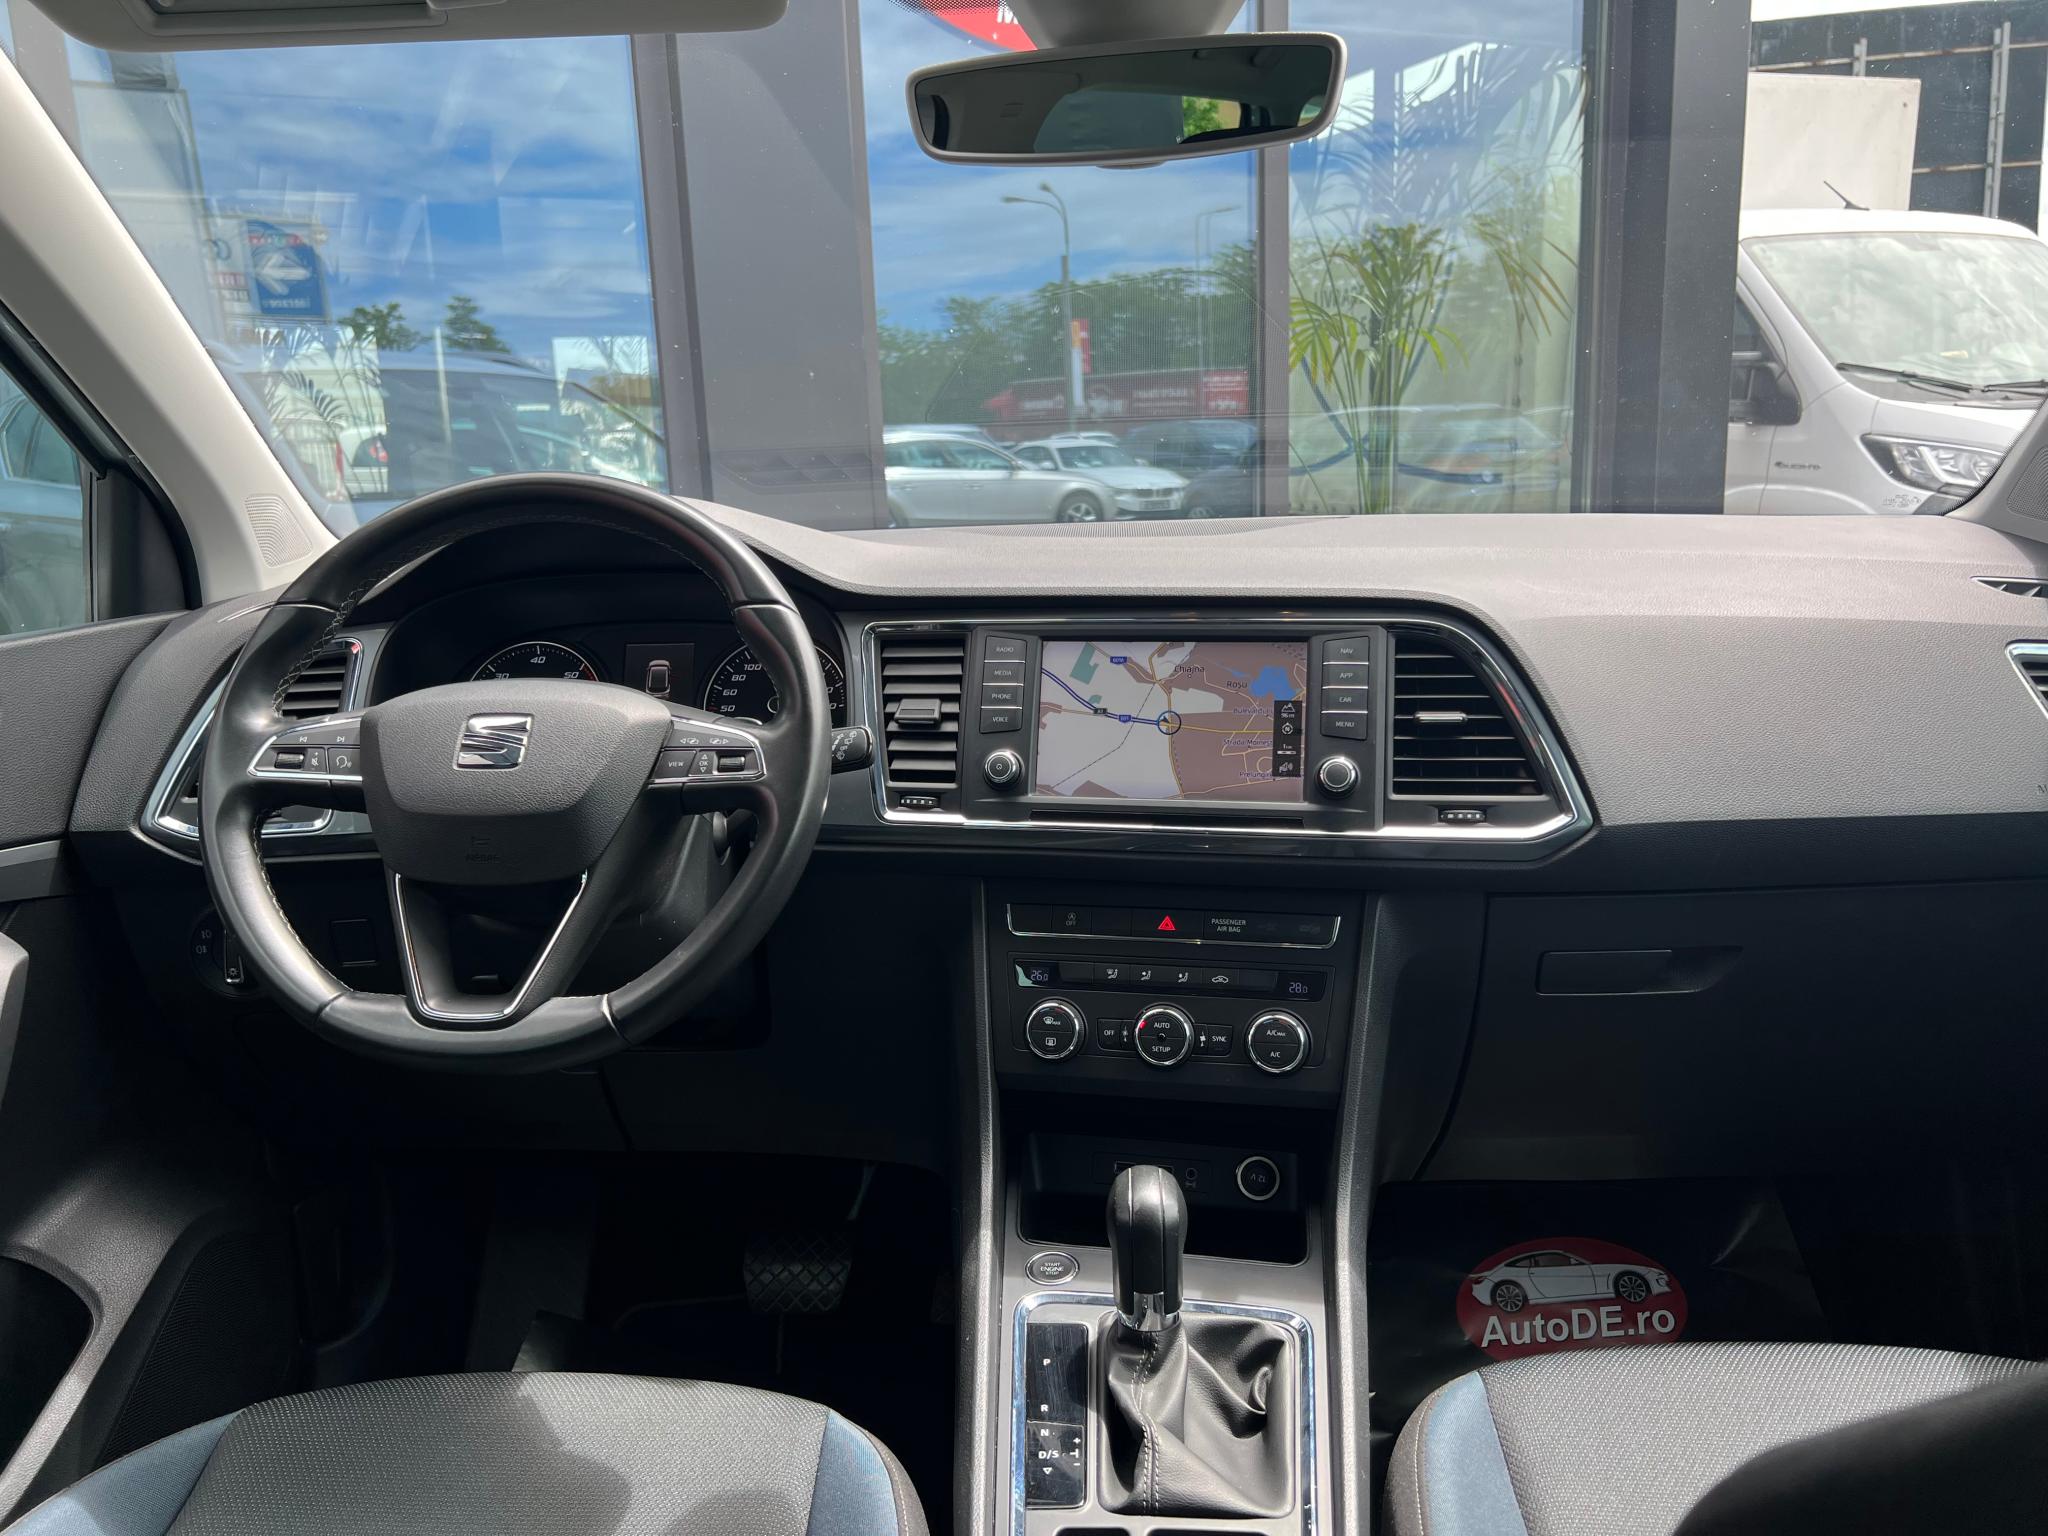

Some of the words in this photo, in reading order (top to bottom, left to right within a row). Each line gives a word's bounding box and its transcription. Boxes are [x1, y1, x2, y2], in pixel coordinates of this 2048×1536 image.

[530, 656, 546, 664] 40
[743, 663, 762, 671] 100
[1174, 665, 1205, 675] Chiajna
[495, 672, 510, 680] 30
[563, 671, 580, 679] 50
[1211, 918, 1247, 926] PASSENGER
[1151, 1045, 1171, 1053] SETUP
[1480, 1304, 1676, 1348] AutoDE.ro
[1043, 1358, 1051, 1366] P
[1040, 1404, 1049, 1412] R
[1040, 1428, 1049, 1436] N
[1038, 1449, 1060, 1460] D/S
